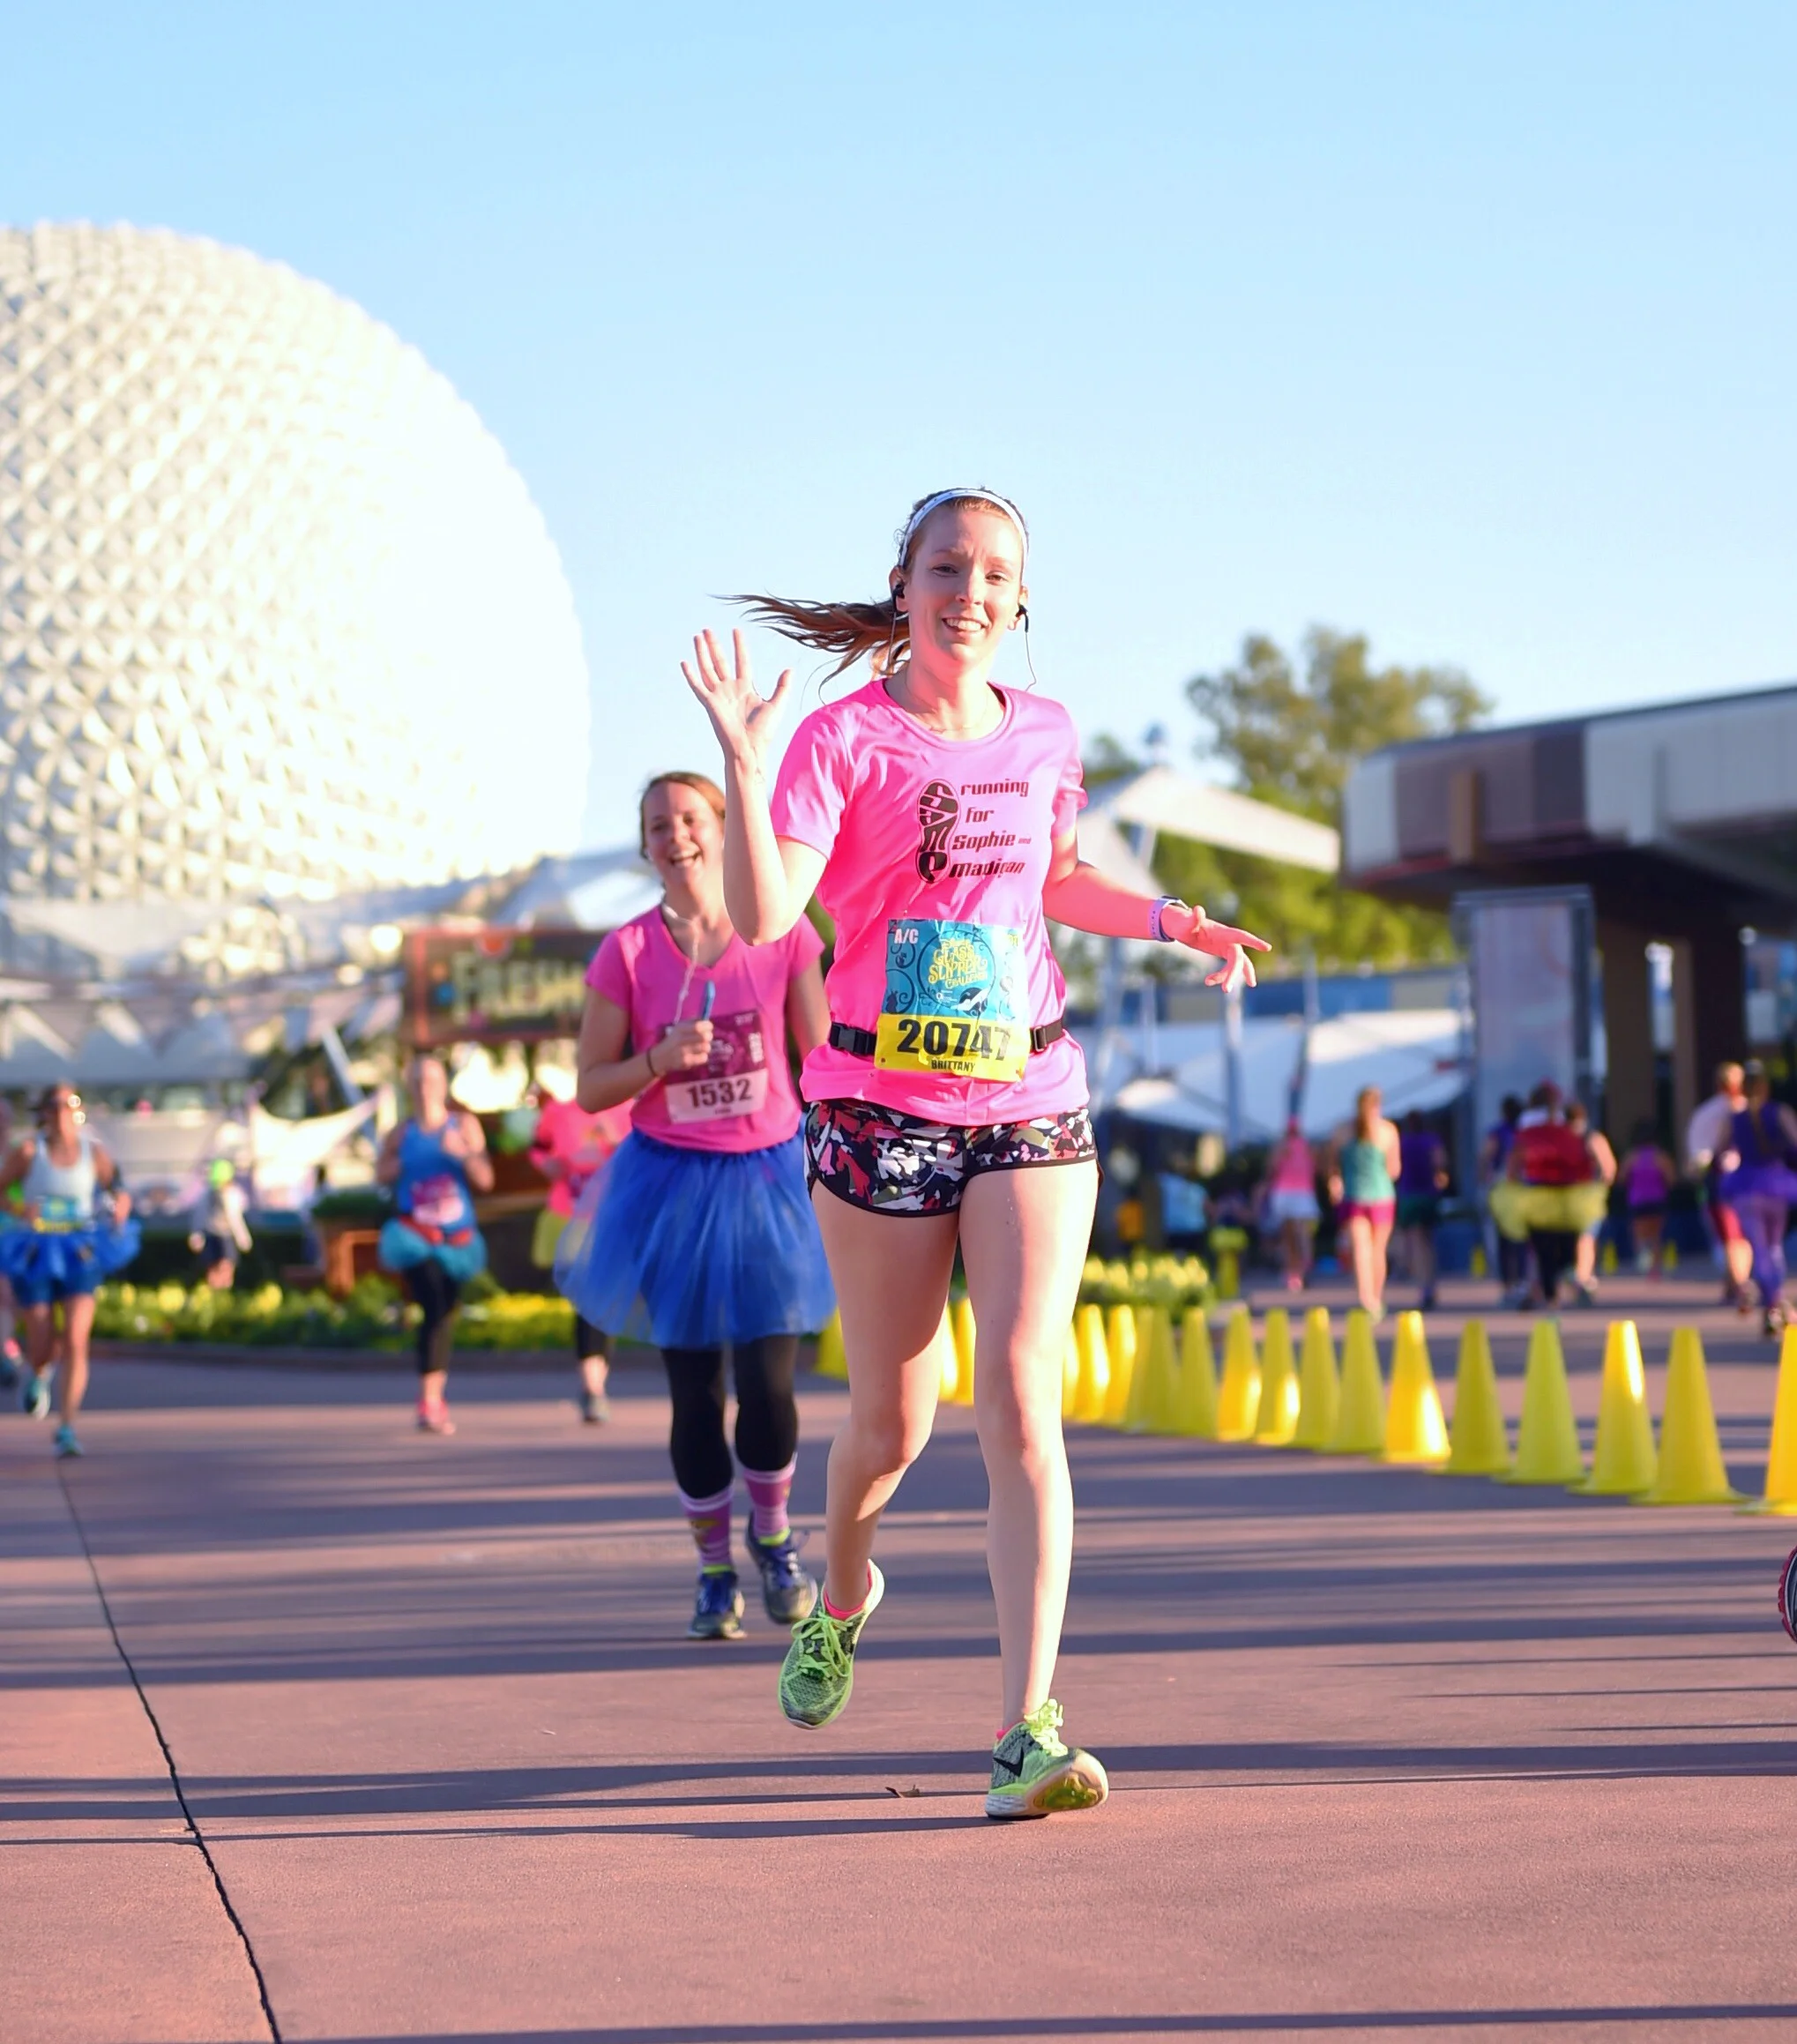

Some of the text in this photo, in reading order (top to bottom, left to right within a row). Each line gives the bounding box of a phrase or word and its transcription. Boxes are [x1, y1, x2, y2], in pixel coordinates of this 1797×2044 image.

[960, 779, 1029, 797] running
[966, 807, 995, 823] for
[951, 831, 1016, 853] Sophie
[894, 928, 919, 944] A/C
[897, 1018, 1011, 1061] 20747
[931, 1060, 976, 1072] BRITTANY
[687, 1078, 753, 1108] 1532
